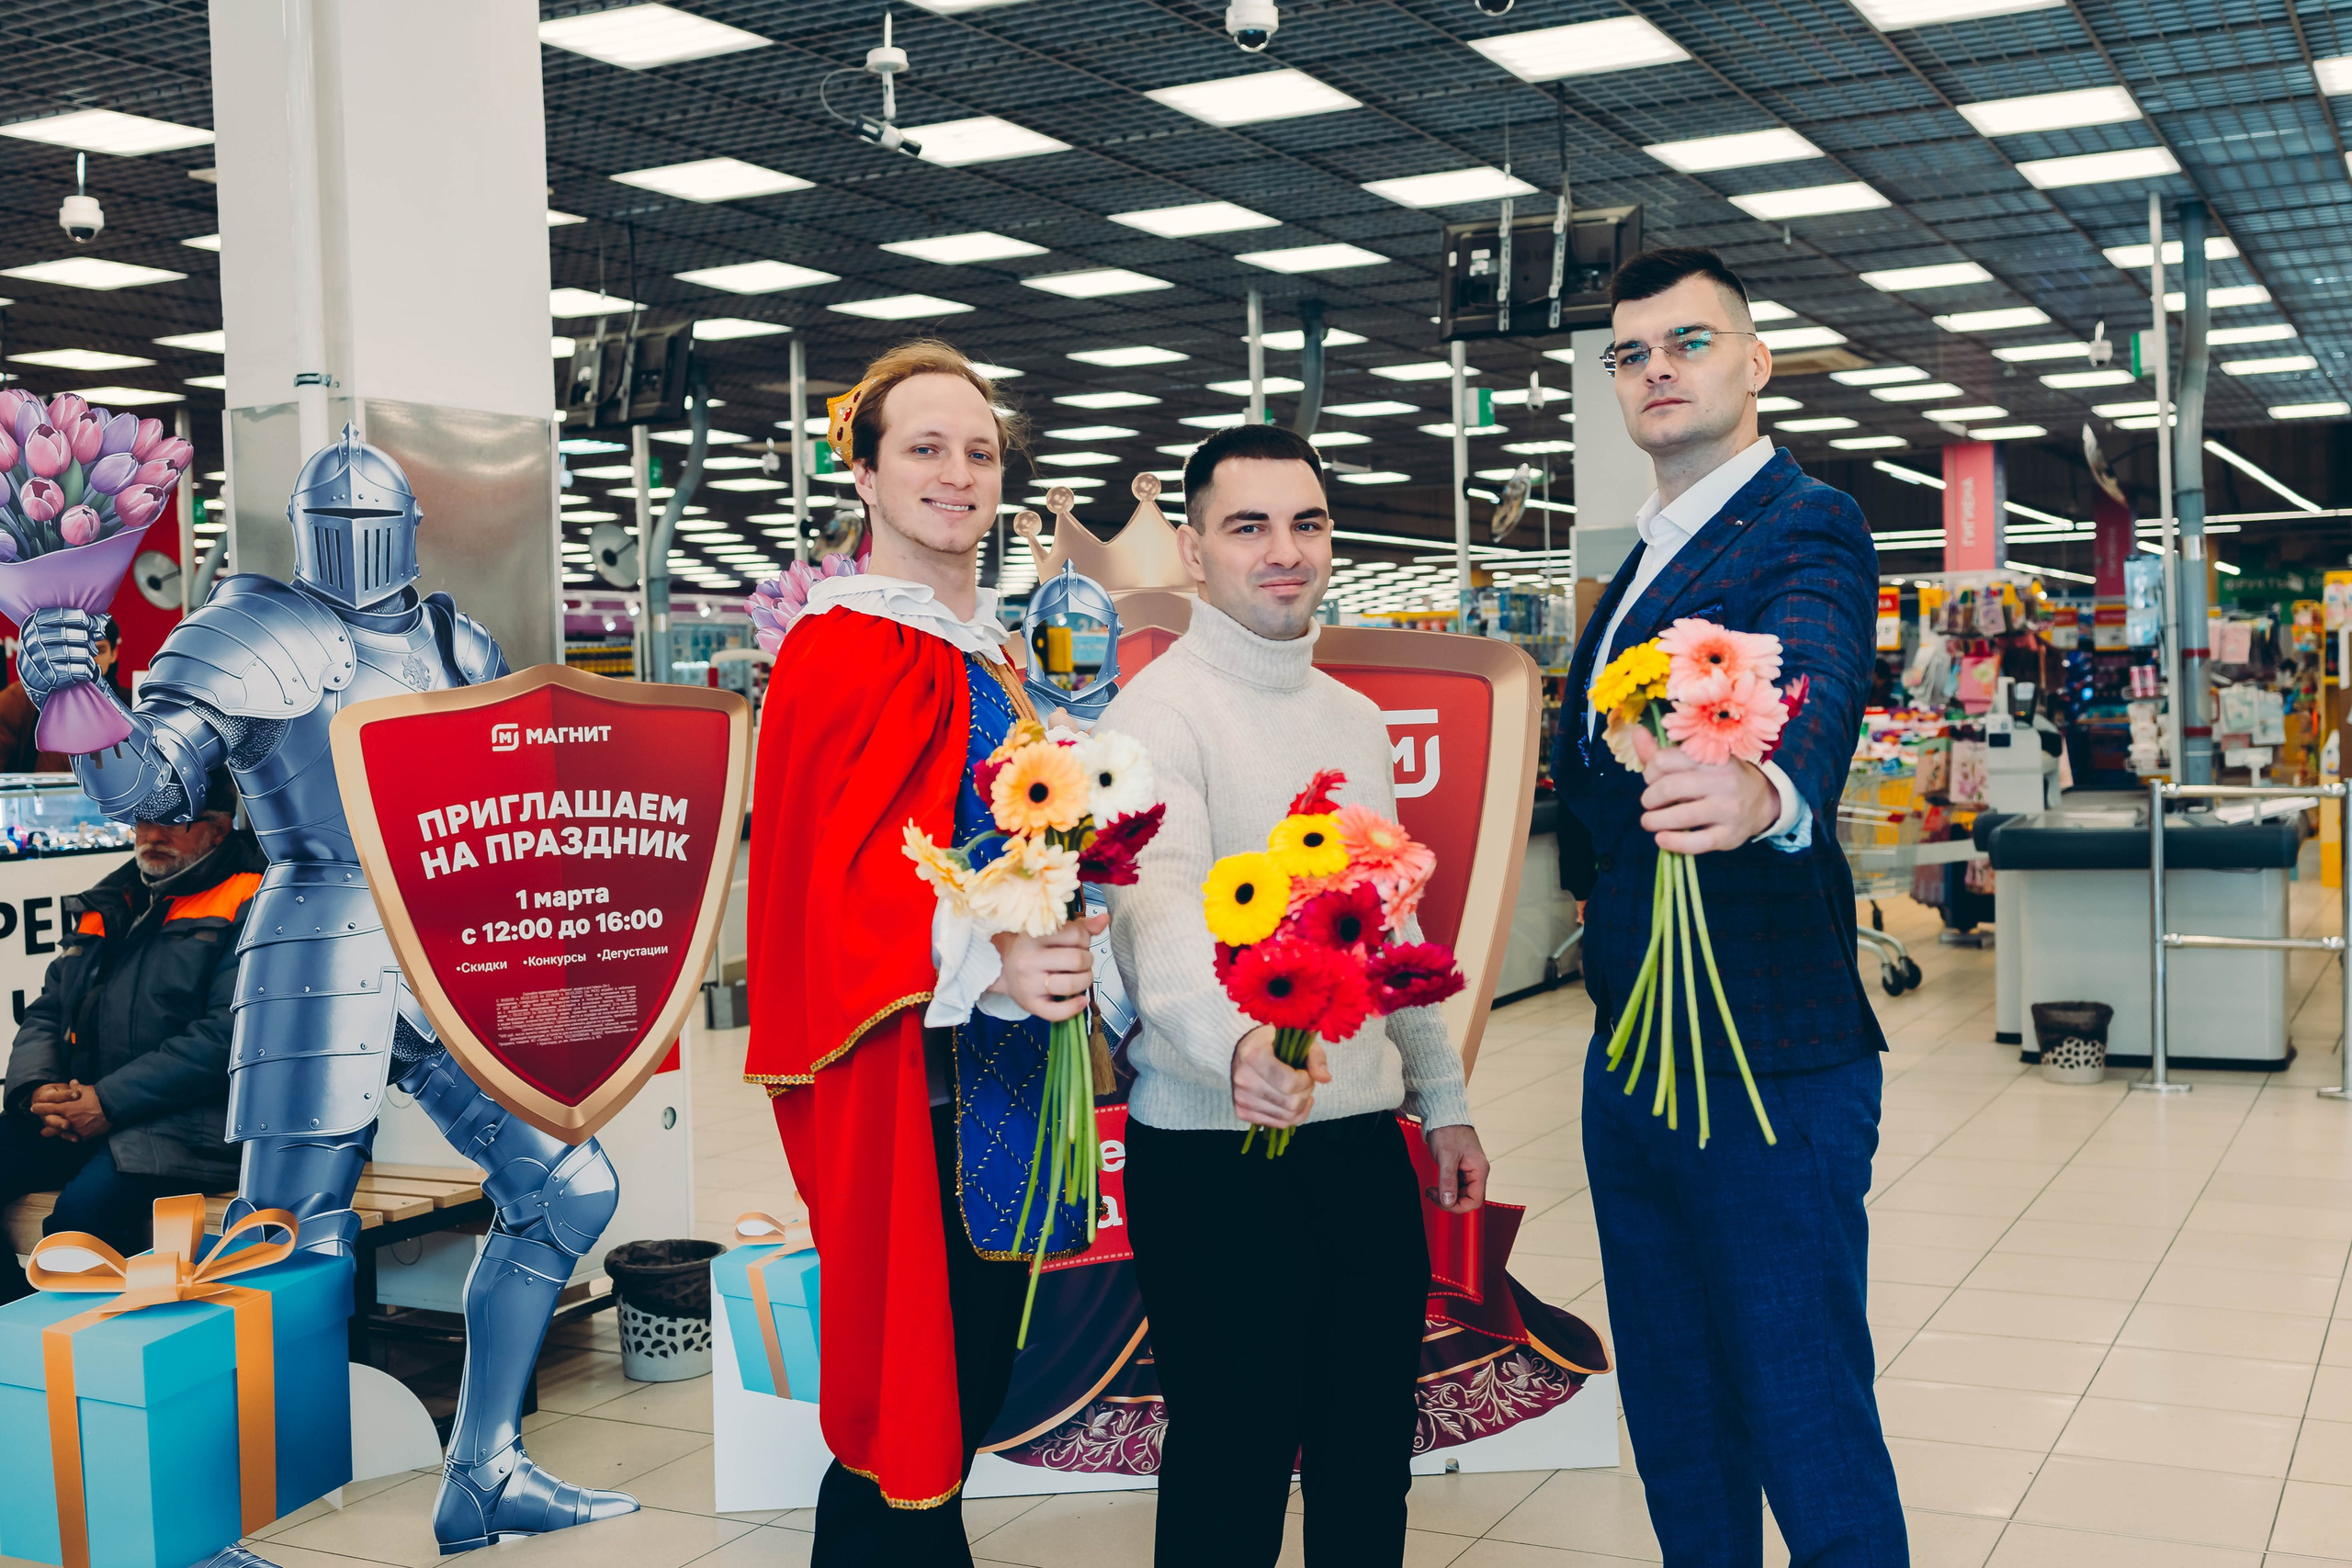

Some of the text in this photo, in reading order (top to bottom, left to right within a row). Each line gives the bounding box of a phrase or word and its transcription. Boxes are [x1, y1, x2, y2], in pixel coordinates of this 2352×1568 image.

[1961, 476, 1974, 547] ГИГИЕНА
[526, 725, 612, 745] МАГНИТ
[417, 789, 689, 842] ПРИГЛАШАЕМ
[420, 826, 690, 880] НА ПРАЗДНИК
[515, 886, 610, 911] 1 марта
[461, 908, 663, 945] с 12:00 до 16:00
